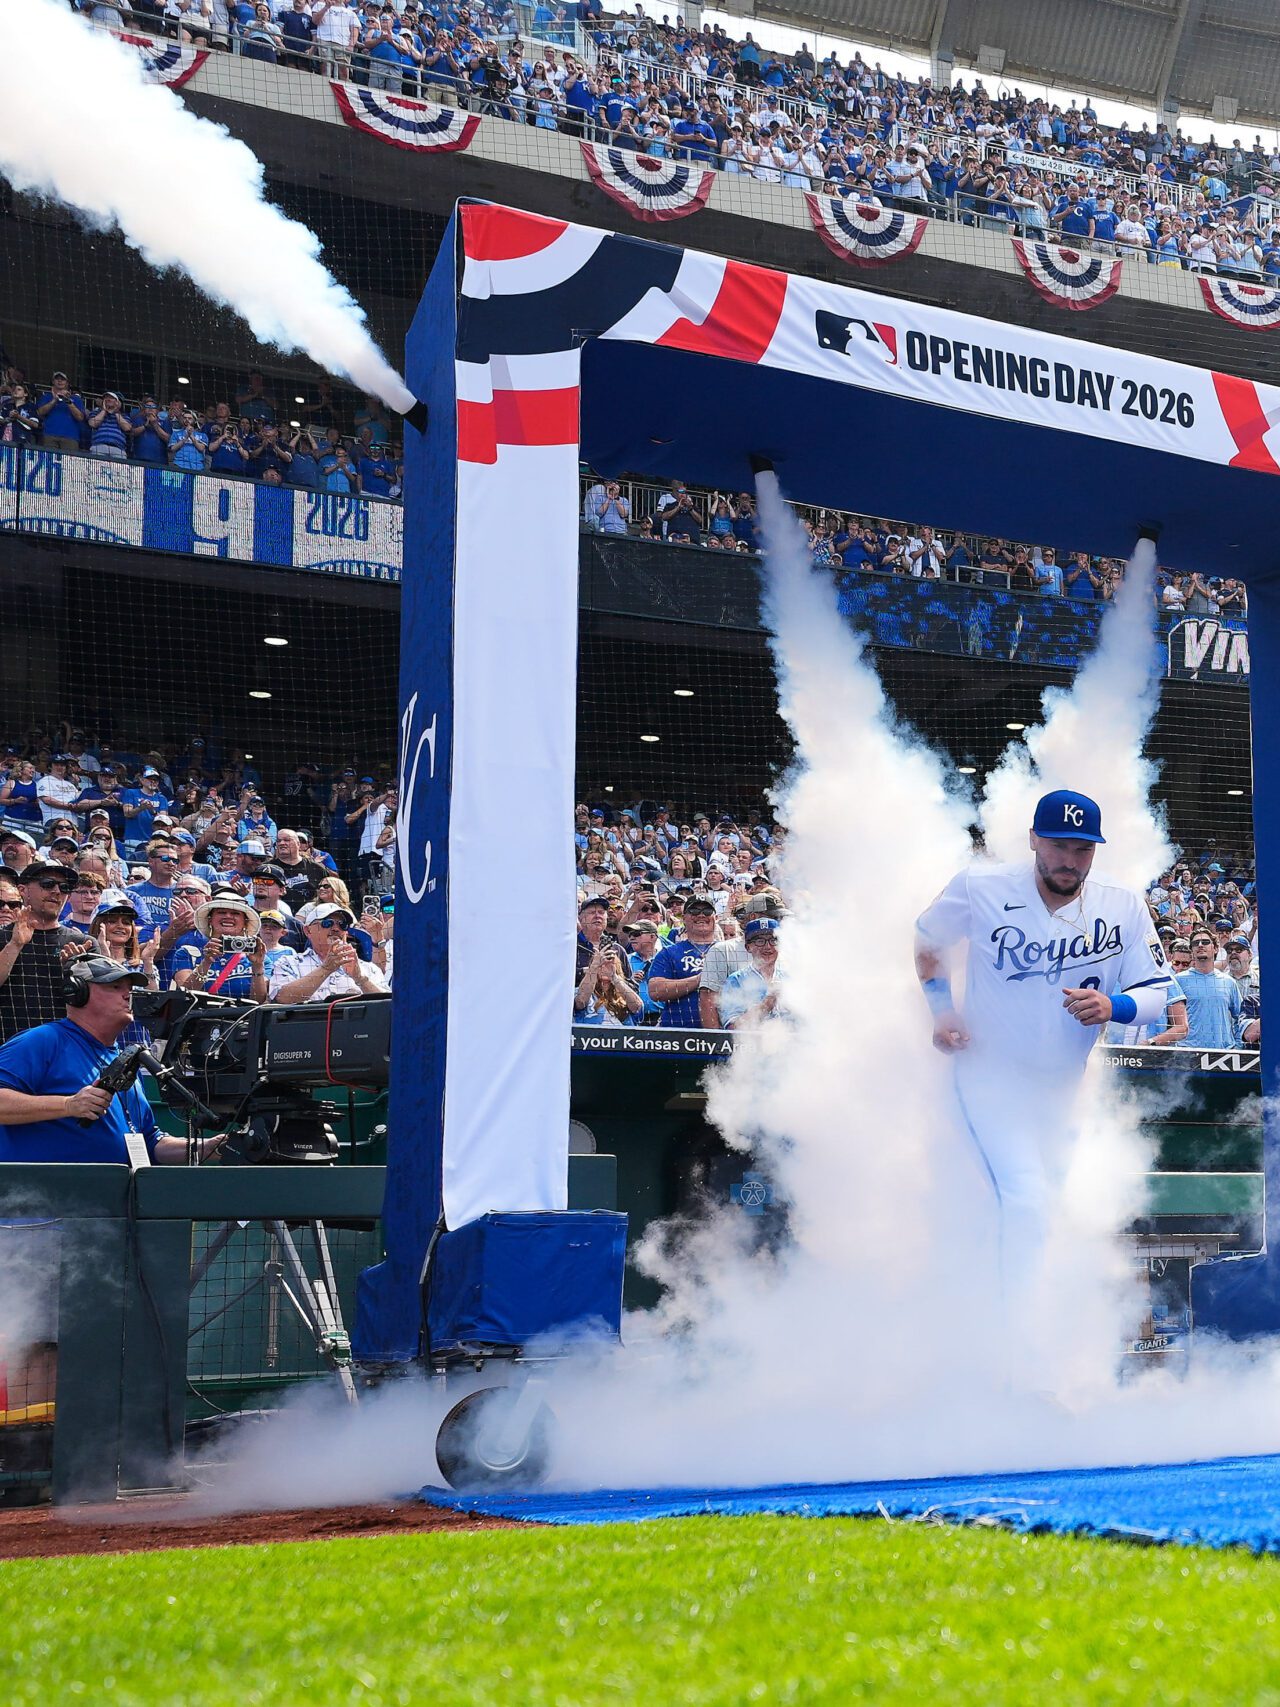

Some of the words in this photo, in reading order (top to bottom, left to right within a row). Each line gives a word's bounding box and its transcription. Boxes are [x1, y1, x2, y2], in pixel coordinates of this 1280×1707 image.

[906, 329, 1050, 399] OPENING
[1054, 362, 1113, 411] DAY
[1121, 379, 1195, 429] 2026
[0, 446, 63, 497] 026
[192, 474, 255, 562] 9
[305, 490, 369, 542] 2026
[1063, 804, 1084, 827] KC
[142, 895, 167, 908] ANSAS
[990, 917, 1124, 986] Royals
[273, 1051, 303, 1060] DIGISUPER
[304, 1050, 312, 1059] 76
[580, 1037, 618, 1051] your
[623, 1035, 680, 1052] Kansas
[684, 1039, 717, 1055] City
[1102, 1054, 1143, 1068] spires
[1138, 1337, 1168, 1351] GIANTS
